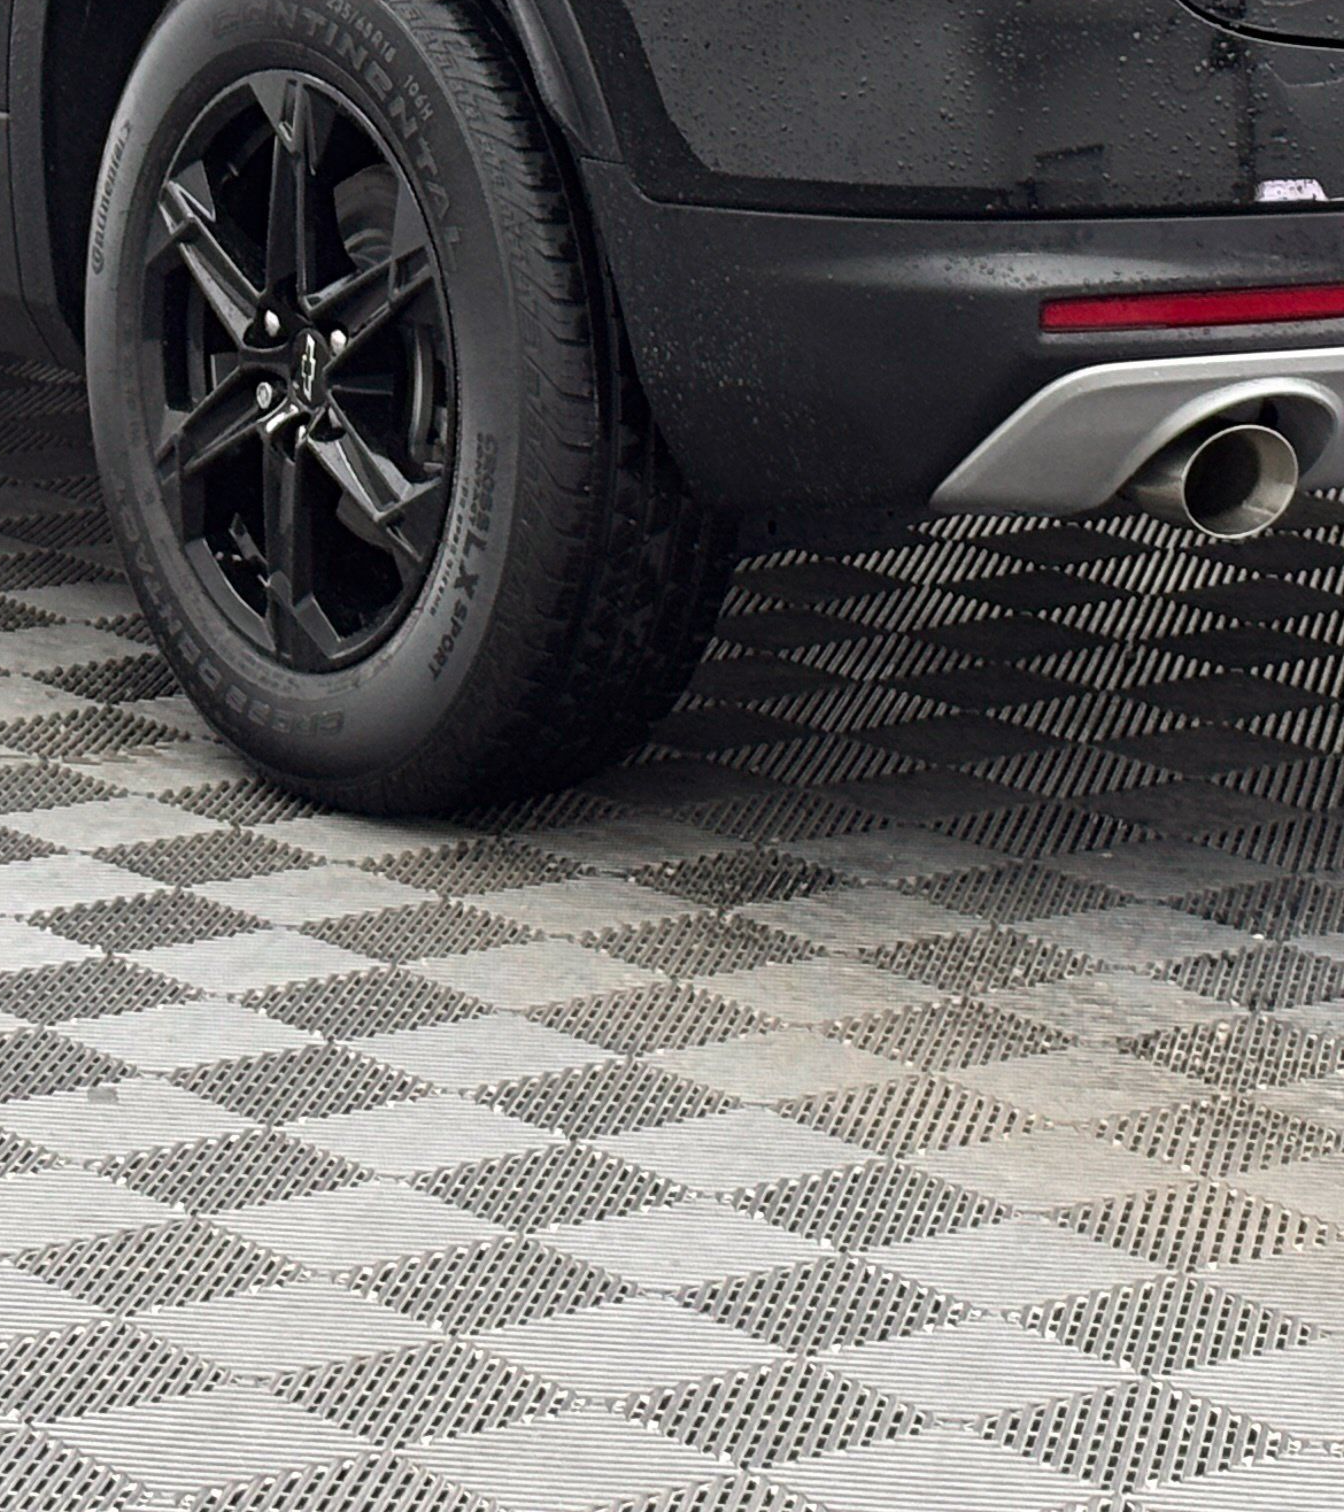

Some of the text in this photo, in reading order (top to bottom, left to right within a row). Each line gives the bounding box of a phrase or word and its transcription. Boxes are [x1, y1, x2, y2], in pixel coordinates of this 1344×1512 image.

[402, 74, 435, 122] 106H
[453, 528, 488, 601] LX
[427, 598, 469, 683] SPORT
